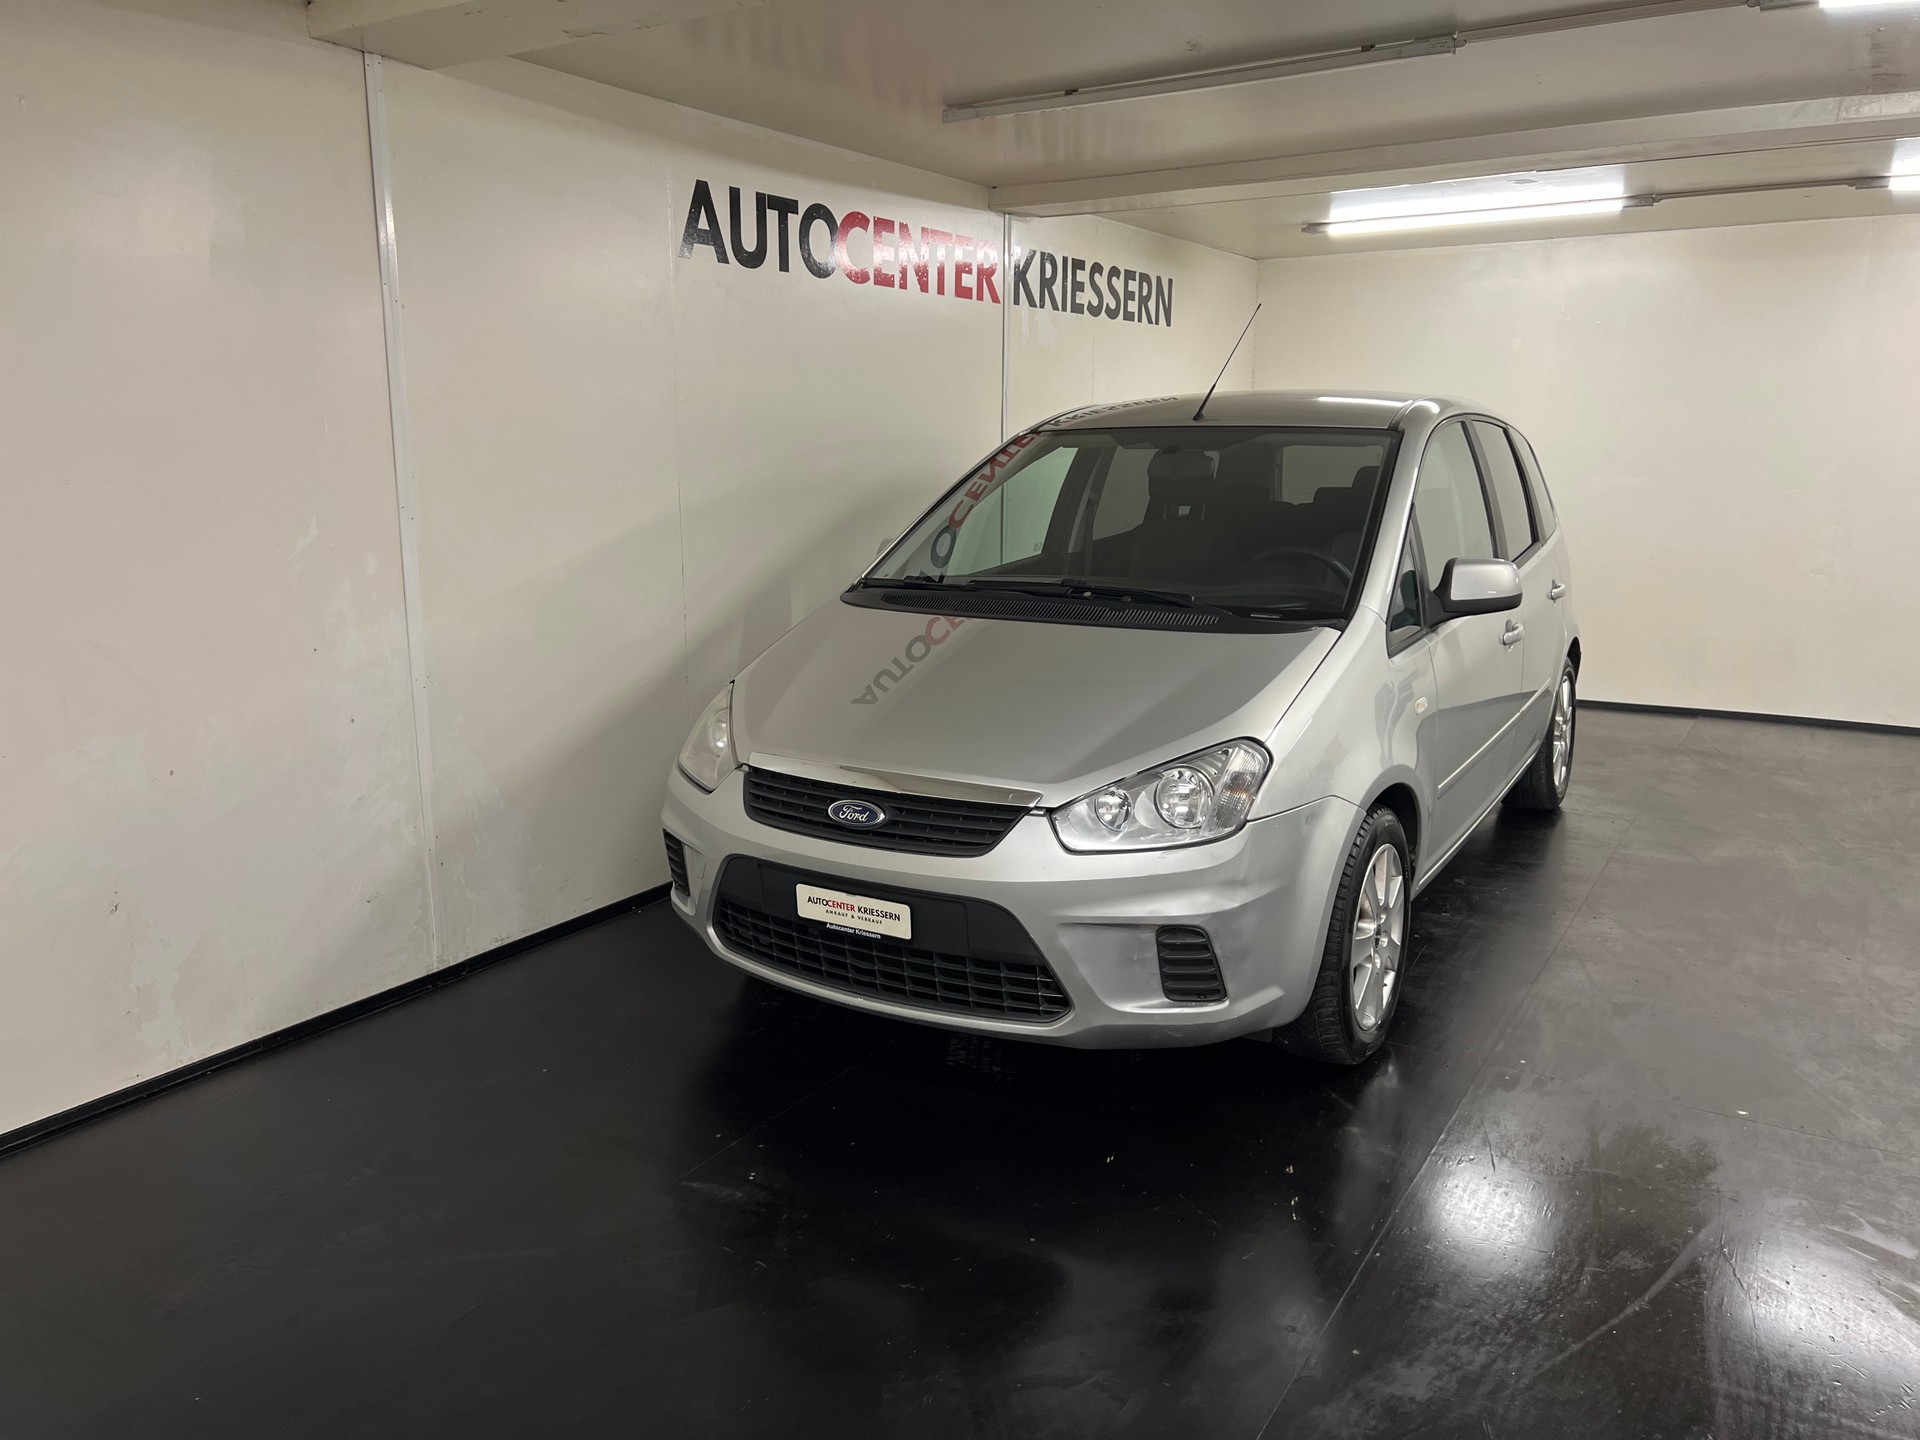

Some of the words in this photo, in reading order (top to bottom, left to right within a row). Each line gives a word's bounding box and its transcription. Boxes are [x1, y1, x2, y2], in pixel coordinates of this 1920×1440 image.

[678, 179, 1001, 304] AUTOCENTER
[1013, 245, 1174, 328] KRIESSERN
[839, 804, 869, 822] Ford
[807, 895, 856, 913] AUTOCENTER
[857, 905, 901, 922] KRIESSERN
[826, 922, 854, 934] Autocenter
[855, 928, 881, 940] Kriessern
